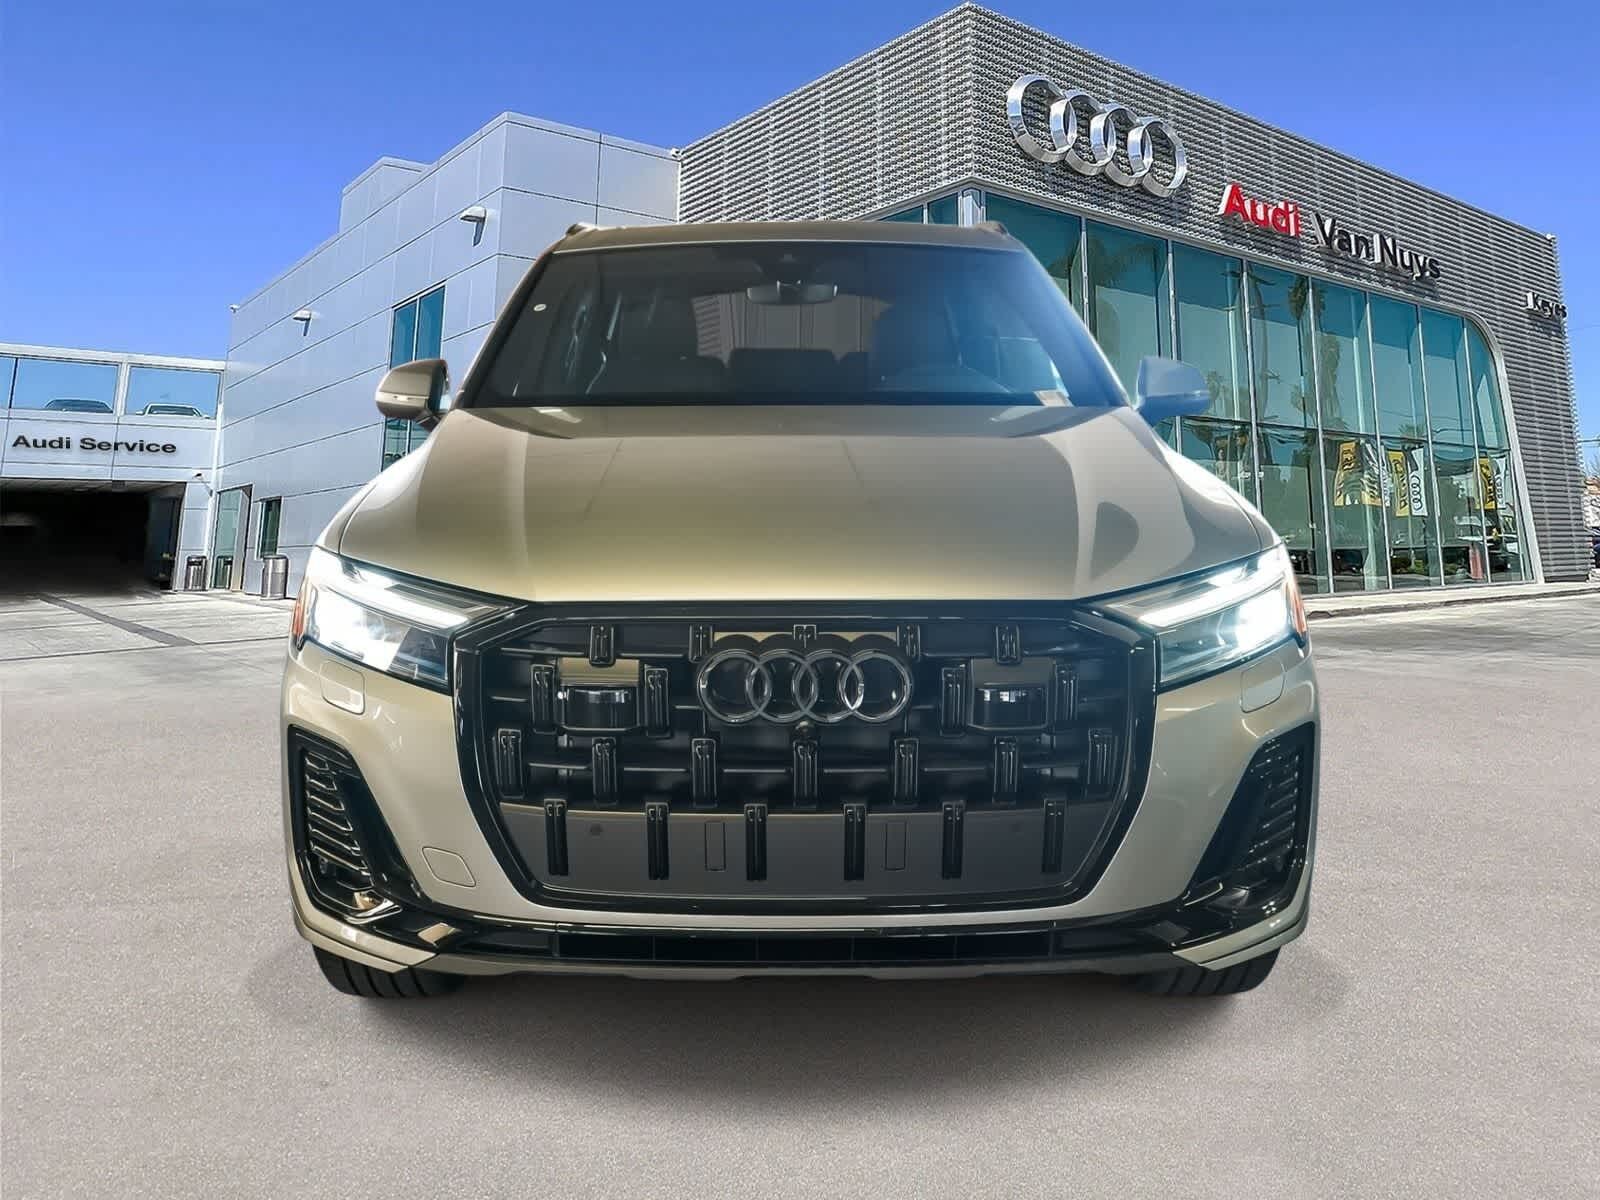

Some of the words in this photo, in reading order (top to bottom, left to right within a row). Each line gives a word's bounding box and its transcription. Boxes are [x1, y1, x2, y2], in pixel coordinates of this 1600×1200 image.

[1218, 181, 1301, 237] Audi
[1311, 211, 1371, 259] Van
[1374, 232, 1441, 280] Nuys
[1527, 292, 1567, 318] Keyes
[12, 435, 71, 449] Audi
[80, 438, 177, 454] Service
